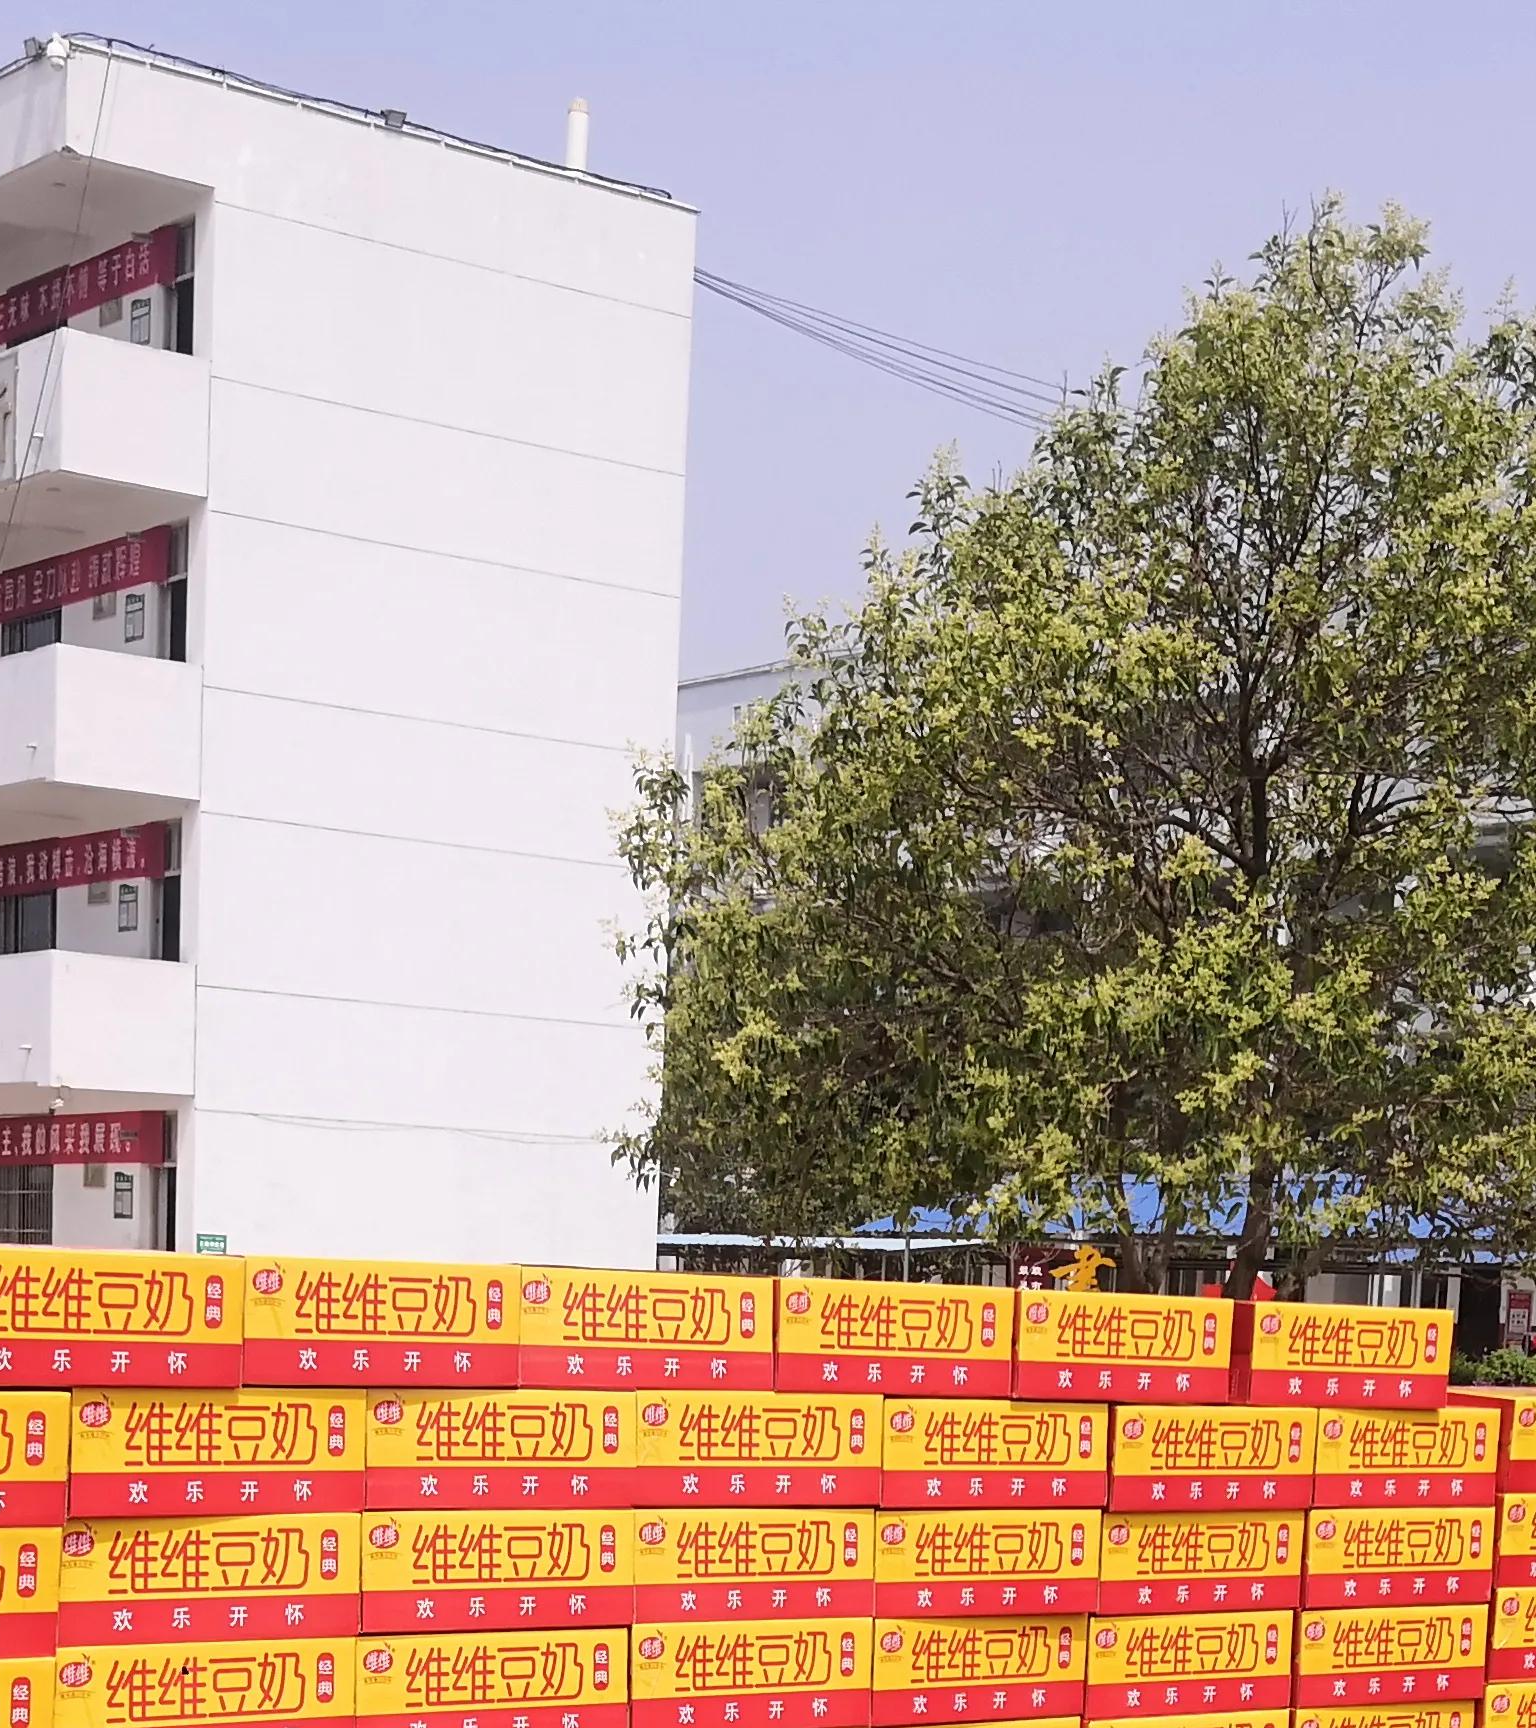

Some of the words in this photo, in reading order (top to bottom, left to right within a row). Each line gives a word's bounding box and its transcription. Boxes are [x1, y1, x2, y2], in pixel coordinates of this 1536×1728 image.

[207, 1282, 224, 1322] 经典
[294, 1269, 477, 1337] 维维豆奶
[486, 1286, 501, 1323] 经典
[559, 1281, 733, 1345] 维维豆奶
[818, 1292, 975, 1353] 维维豆奶
[297, 1347, 470, 1371] 欢乐开怀
[1056, 1304, 1196, 1361] 维维豆奶
[1286, 1315, 1419, 1369] 维维豆奶
[561, 1354, 726, 1377] 欢乐开怀
[820, 1362, 968, 1383] 欢乐开怀
[1057, 1370, 1190, 1389] 欢乐开怀
[1287, 1377, 1413, 1395] 欢乐开怀
[106, 1525, 312, 1595] 维维豆奶
[676, 1518, 836, 1580] 维维豆奶
[1136, 1520, 1271, 1576] 维维豆奶
